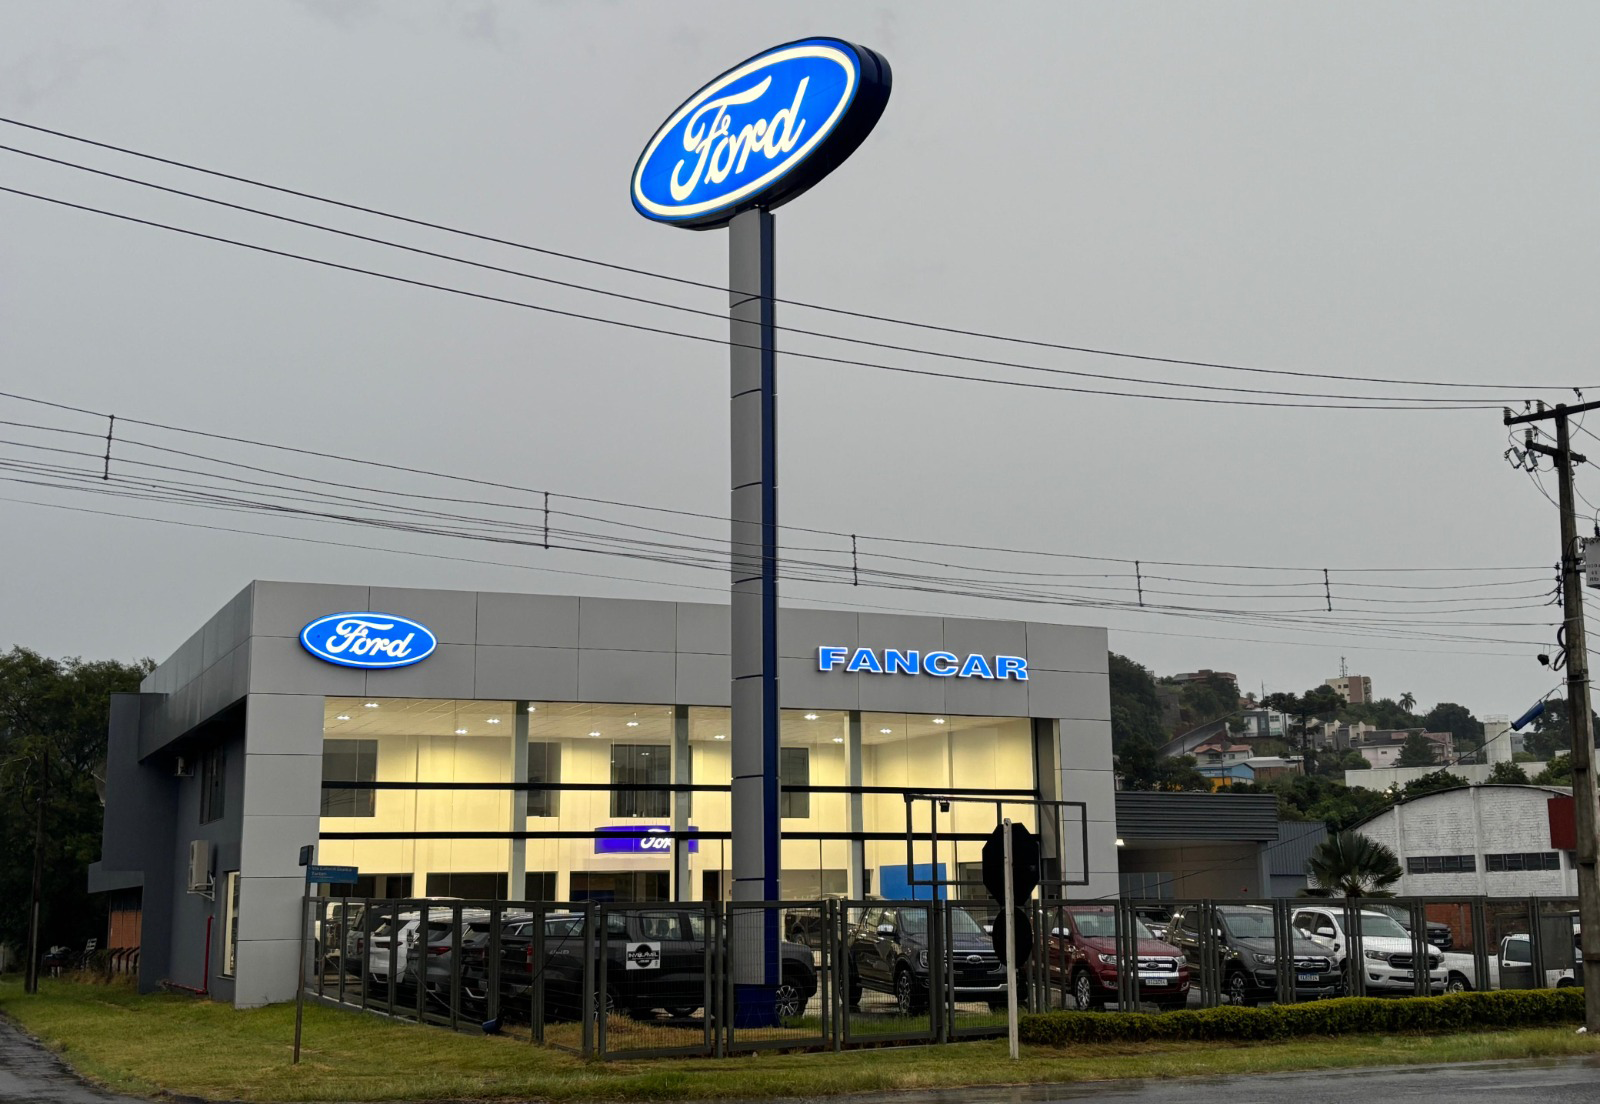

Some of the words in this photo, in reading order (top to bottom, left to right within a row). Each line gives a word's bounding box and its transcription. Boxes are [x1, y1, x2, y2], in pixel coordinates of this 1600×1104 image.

[670, 75, 810, 201] Ford
[325, 619, 415, 658] Ford
[818, 646, 1029, 681] FANCAR
